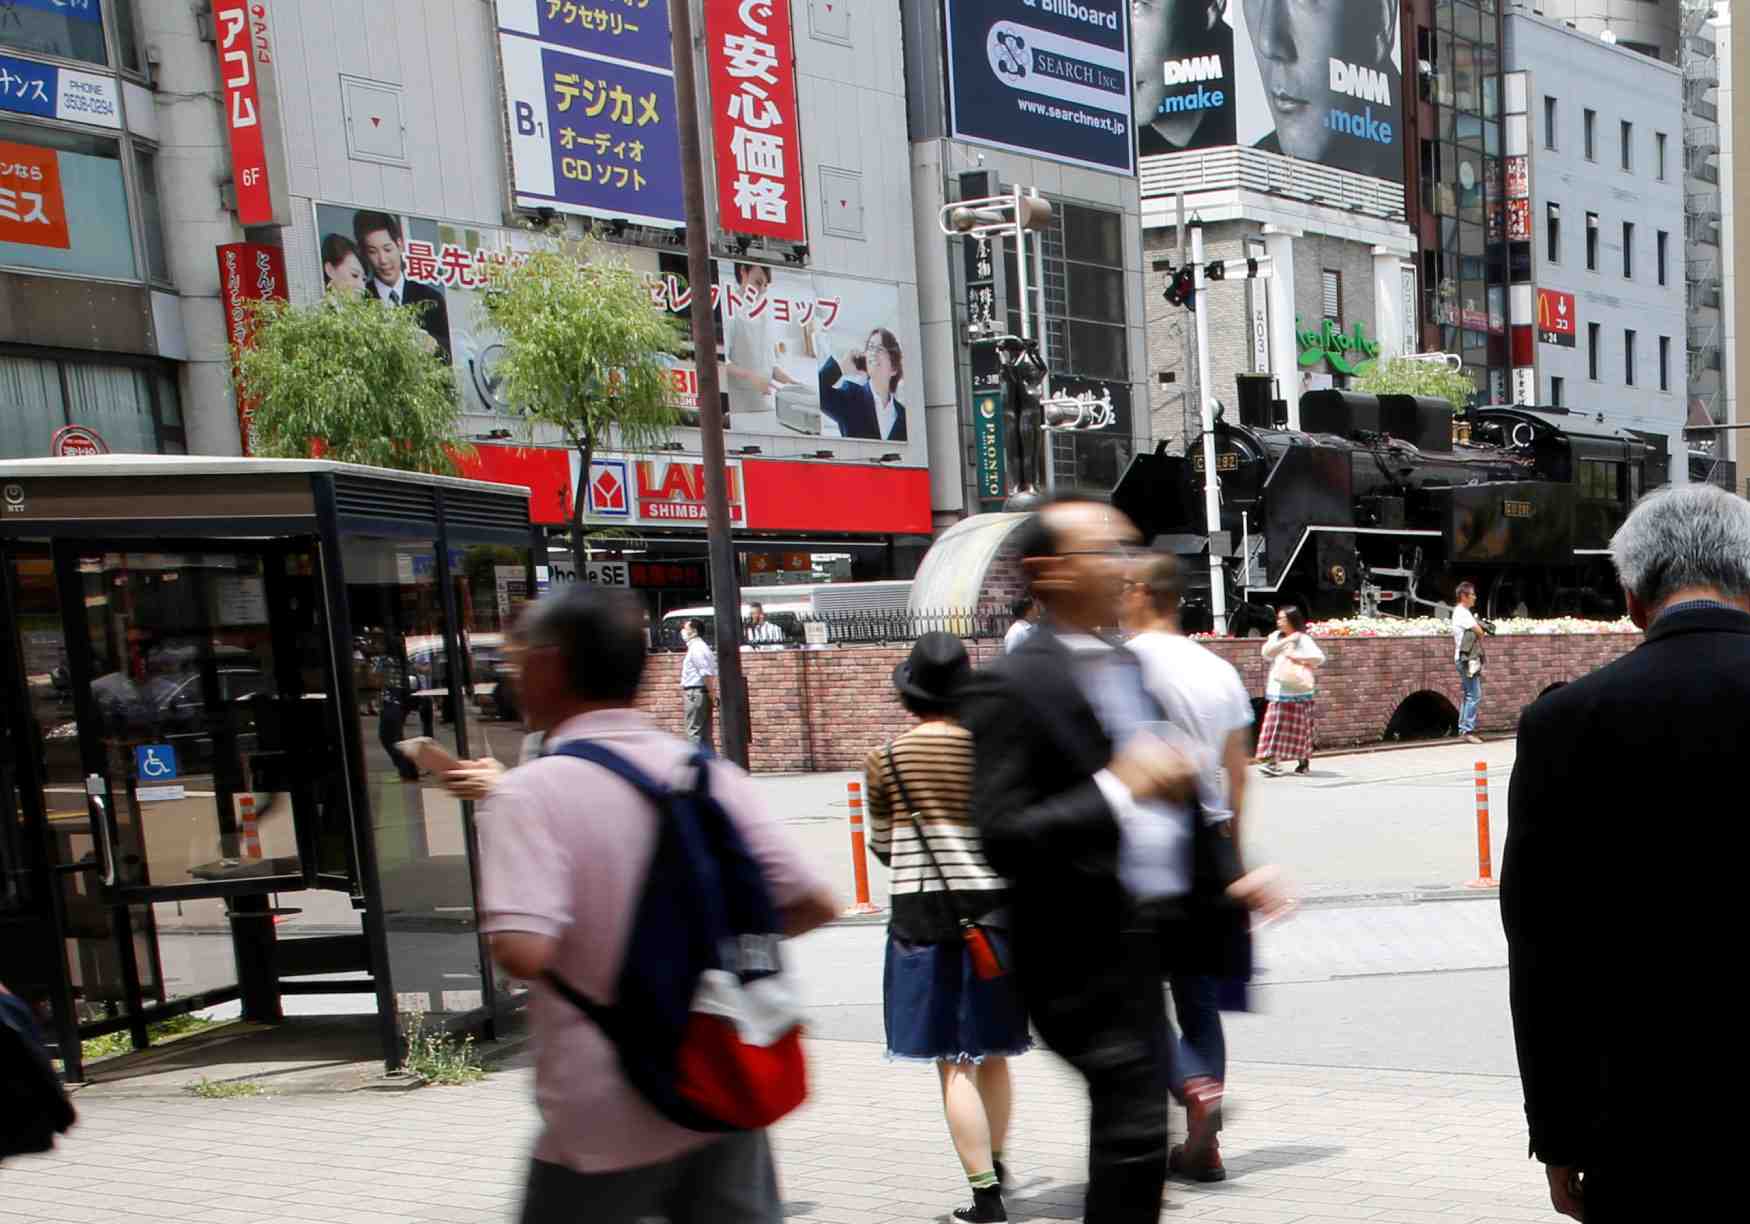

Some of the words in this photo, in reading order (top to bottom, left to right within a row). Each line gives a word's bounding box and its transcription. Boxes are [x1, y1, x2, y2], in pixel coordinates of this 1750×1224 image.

[545, 3, 640, 35] アクセサリー
[219, 8, 257, 129] アコム
[1037, 54, 1094, 83] SEARCH
[1164, 54, 1223, 86] DMM
[1328, 58, 1391, 106] DMM
[68, 79, 103, 96] PHONE
[553, 73, 661, 126] デジカメ
[1157, 85, 1224, 113] .make
[722, 0, 789, 225] で安心価格
[1017, 98, 1126, 135] www.searchnext.jp
[1324, 105, 1393, 145] .make
[559, 127, 646, 163] オーディオ
[242, 167, 260, 187] 6F
[561, 157, 592, 182] CD
[596, 163, 647, 191] ソフト
[985, 423, 1000, 495] PRONTO
[649, 503, 734, 520] SHIMBAI
[601, 565, 625, 585] SE
